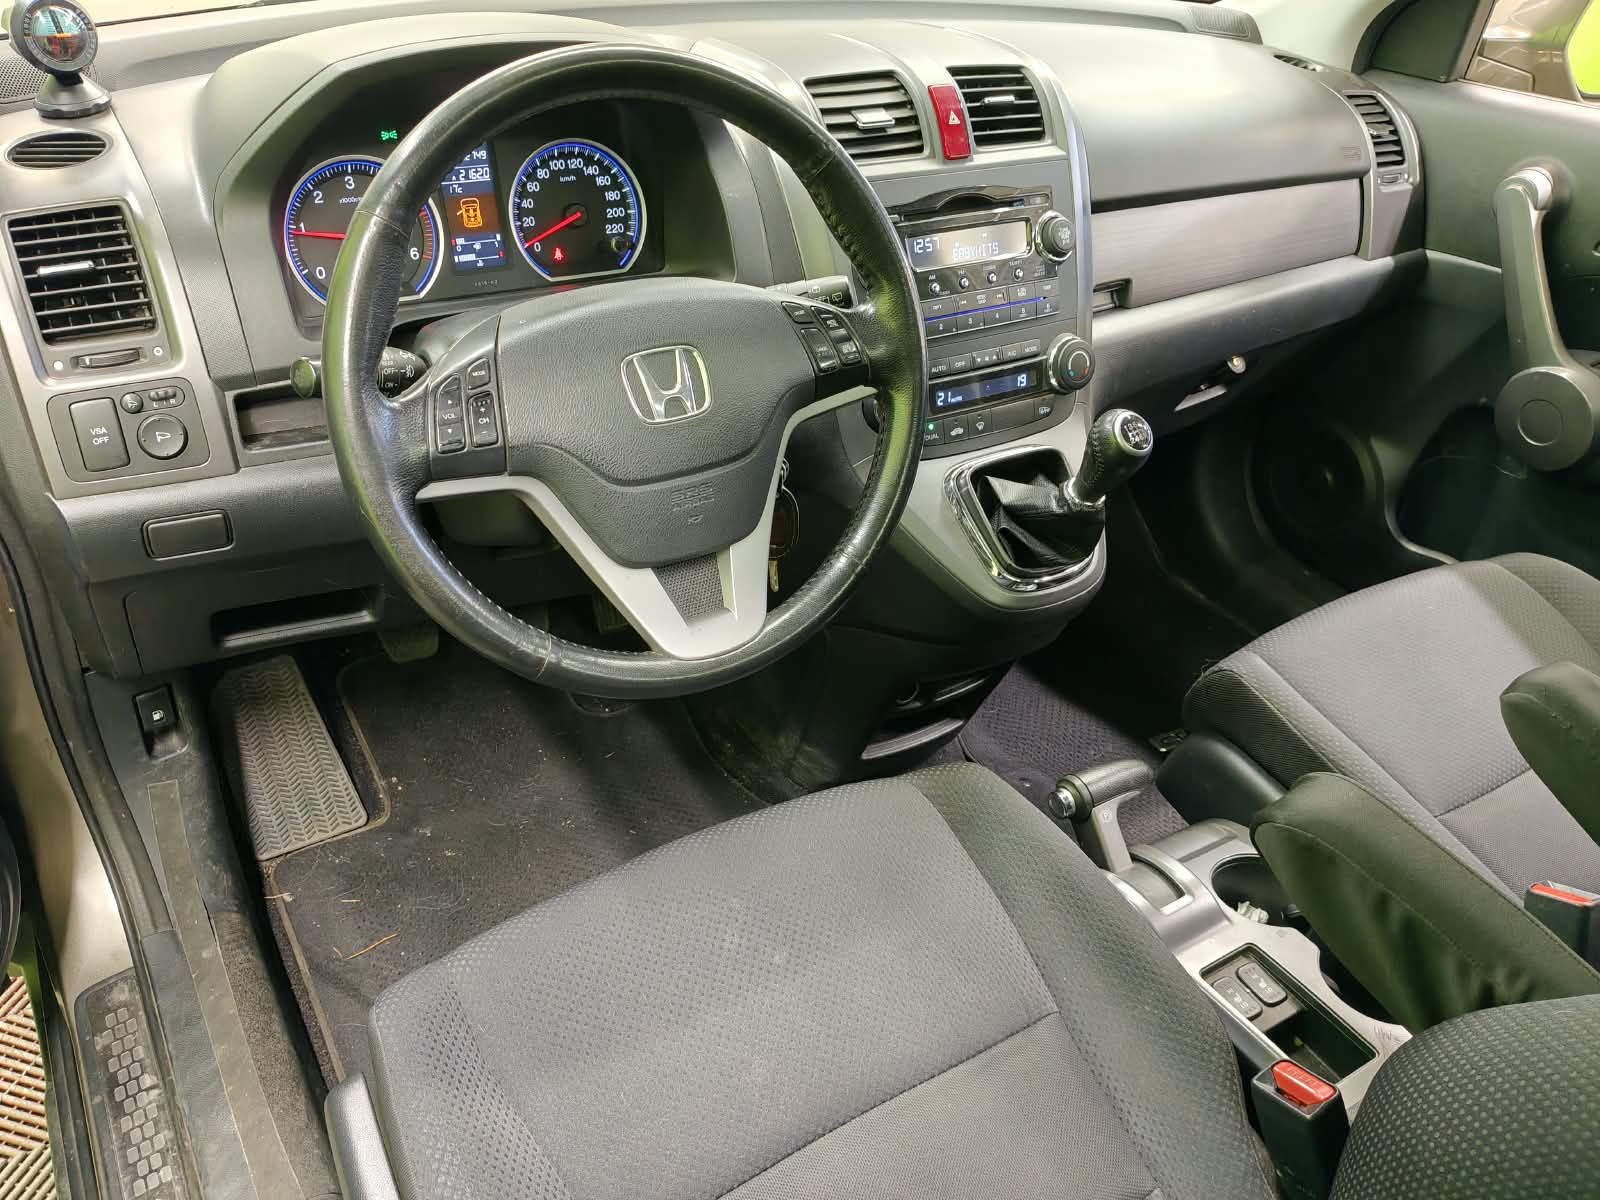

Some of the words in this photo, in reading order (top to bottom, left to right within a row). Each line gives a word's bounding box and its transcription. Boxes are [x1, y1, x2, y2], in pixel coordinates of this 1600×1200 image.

[549, 160, 565, 170] 100
[567, 158, 583, 169] 120
[537, 168, 550, 179] 80
[583, 165, 599, 176] 140
[345, 176, 355, 189] 3
[595, 175, 611, 186] 160
[527, 181, 540, 192] 60
[313, 190, 324, 203] 2
[605, 190, 620, 201] 180
[521, 198, 534, 208] 40
[606, 207, 625, 218] 200
[299, 222, 306, 232] 1
[523, 216, 535, 227] 20
[605, 223, 624, 234] 220
[534, 242, 541, 252] 0
[409, 247, 420, 260] 6
[315, 266, 326, 279] 0
[931, 365, 947, 373] AUTO
[954, 361, 966, 369] OFF
[1017, 373, 1027, 387] 19
[936, 391, 951, 407] 21
[90, 426, 108, 435] VSA
[92, 436, 110, 445] OFF
